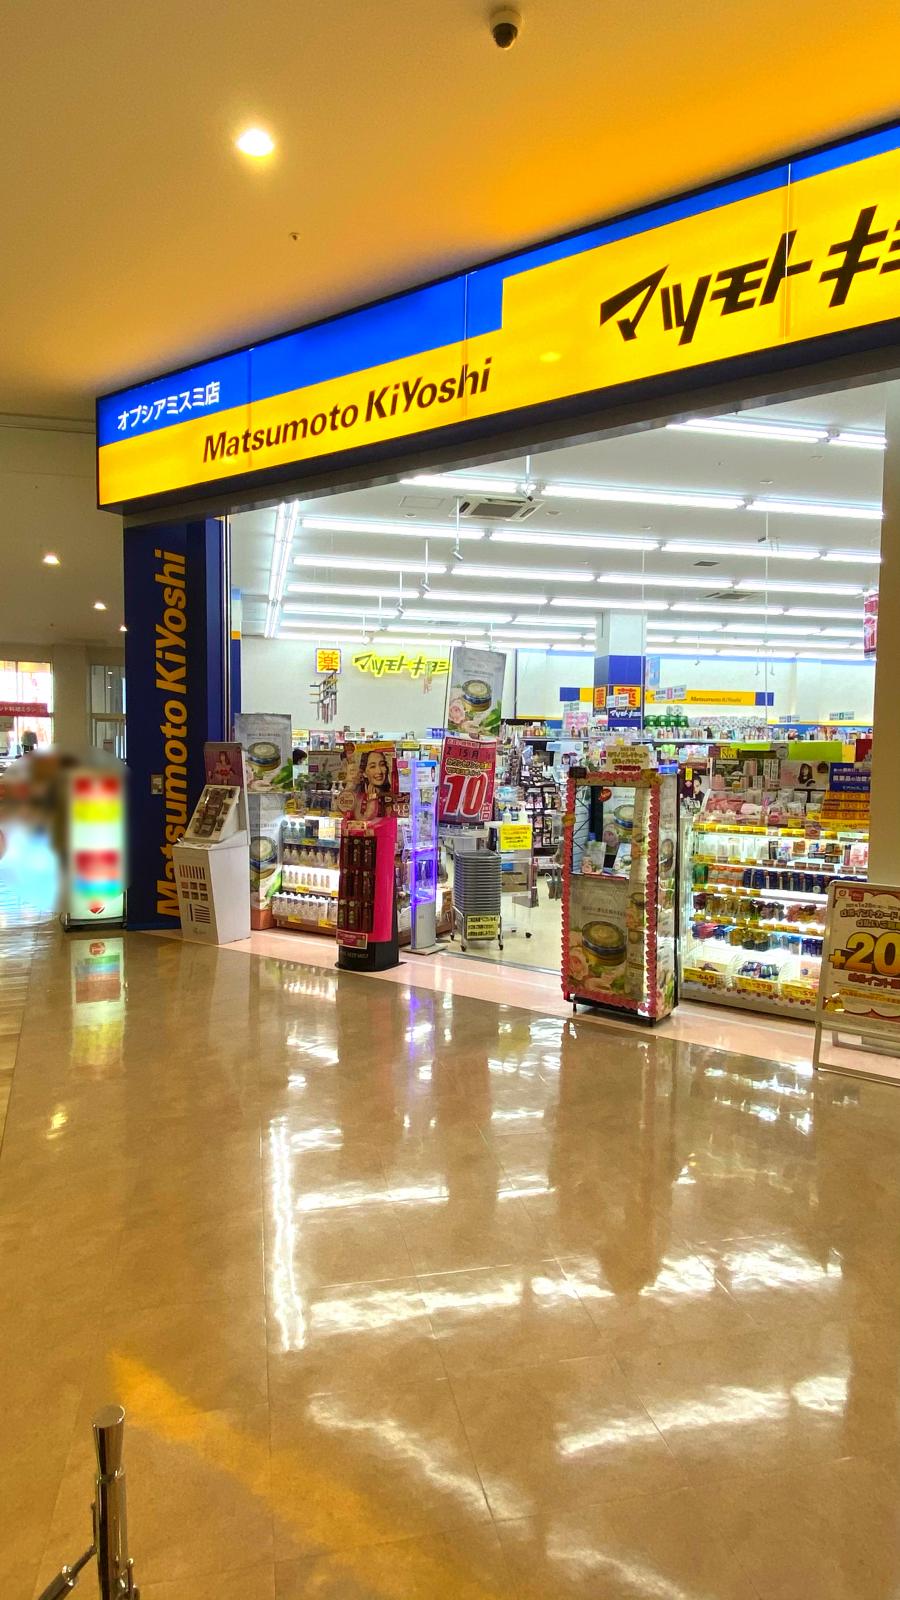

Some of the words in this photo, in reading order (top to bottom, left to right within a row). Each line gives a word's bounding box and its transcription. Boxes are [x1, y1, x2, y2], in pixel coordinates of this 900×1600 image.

[117, 381, 220, 430] オプシアミスミ店
[203, 403, 358, 462] Matsumoto
[365, 357, 492, 422] KiYoshi
[155, 548, 187, 694] KiYoshi
[319, 651, 339, 670] 薬
